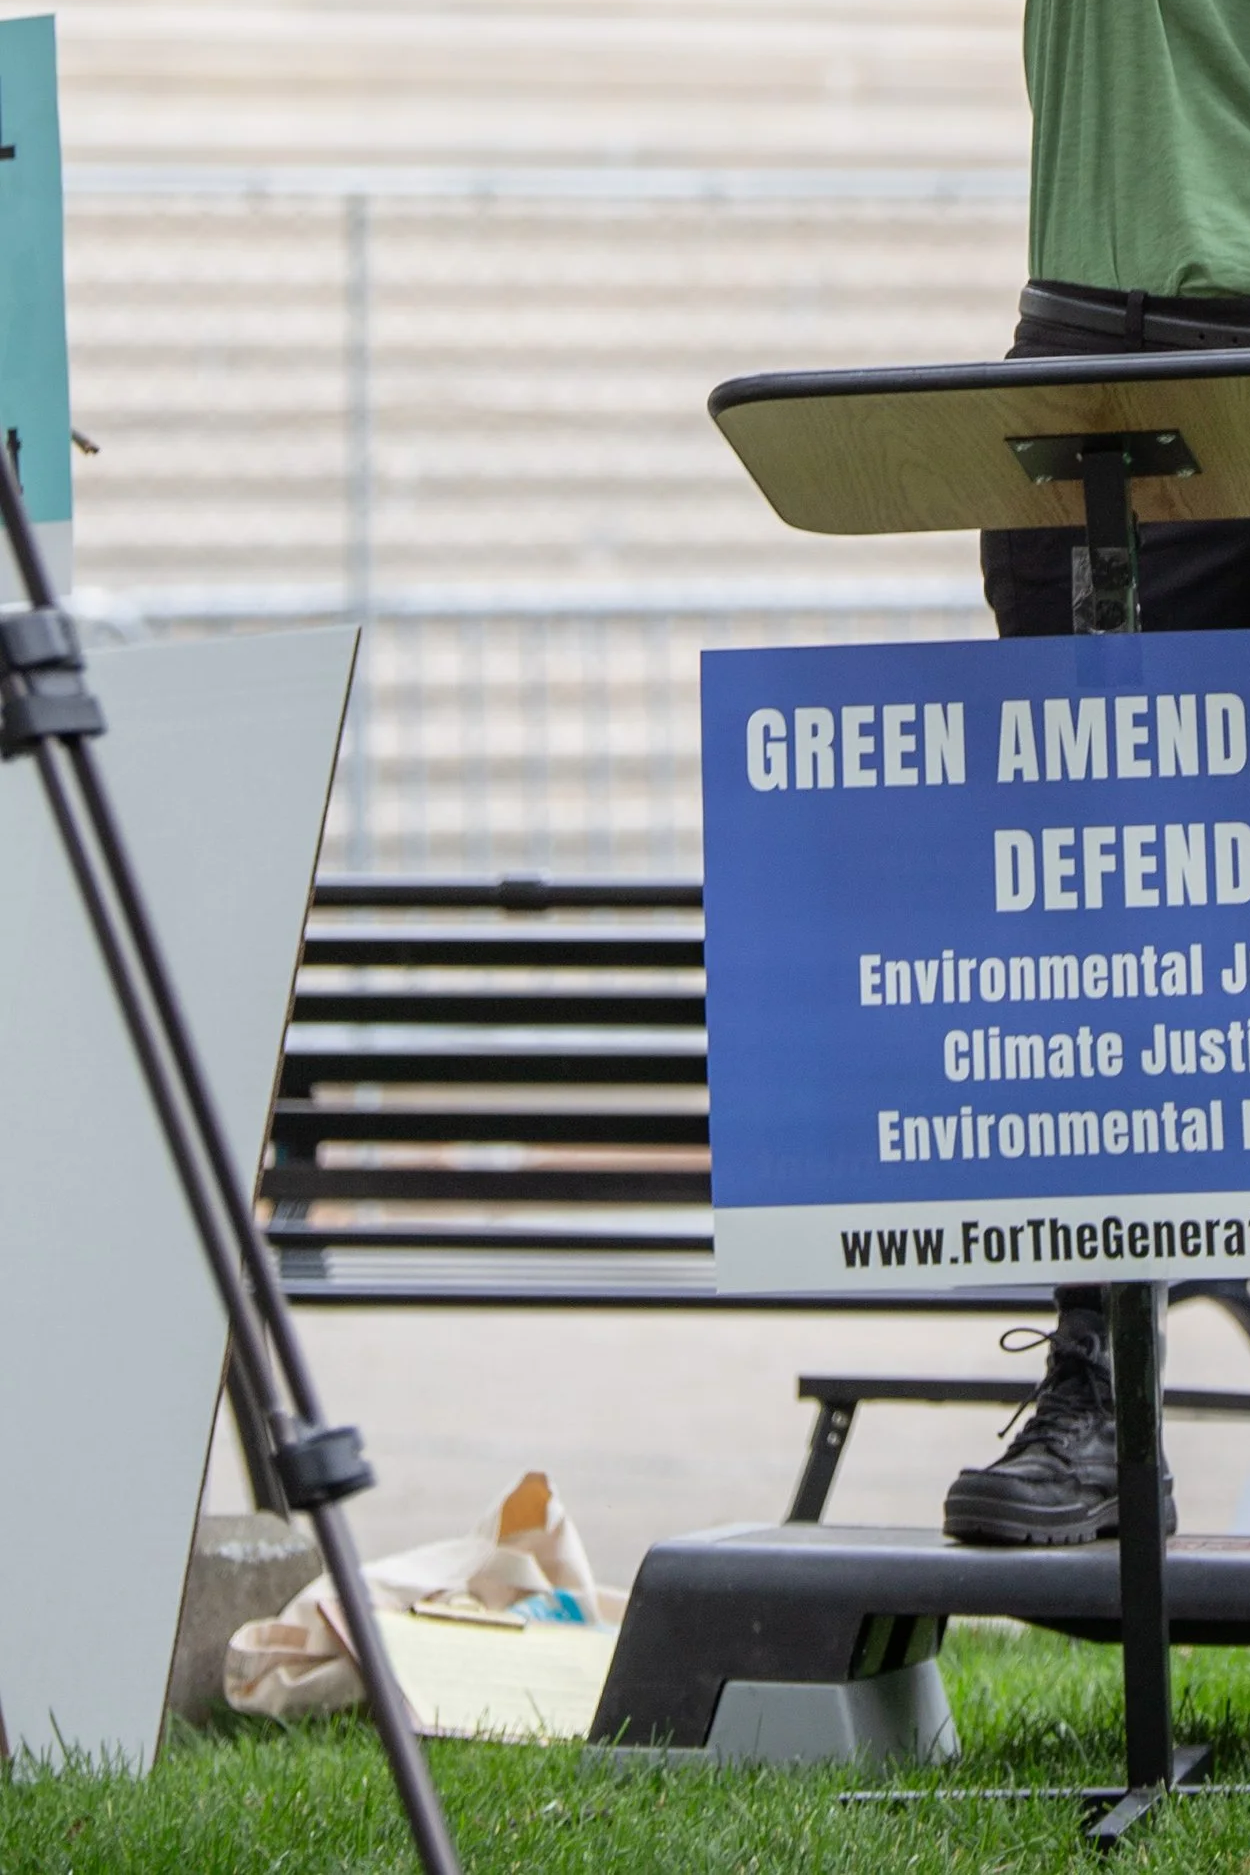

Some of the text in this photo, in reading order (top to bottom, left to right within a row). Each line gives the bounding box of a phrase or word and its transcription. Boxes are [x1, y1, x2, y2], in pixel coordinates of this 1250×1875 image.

[746, 702, 967, 792] GREEN
[859, 941, 1205, 1006] Environmental
[943, 1023, 1124, 1083] Climate
[877, 1099, 1225, 1163] Environmental
